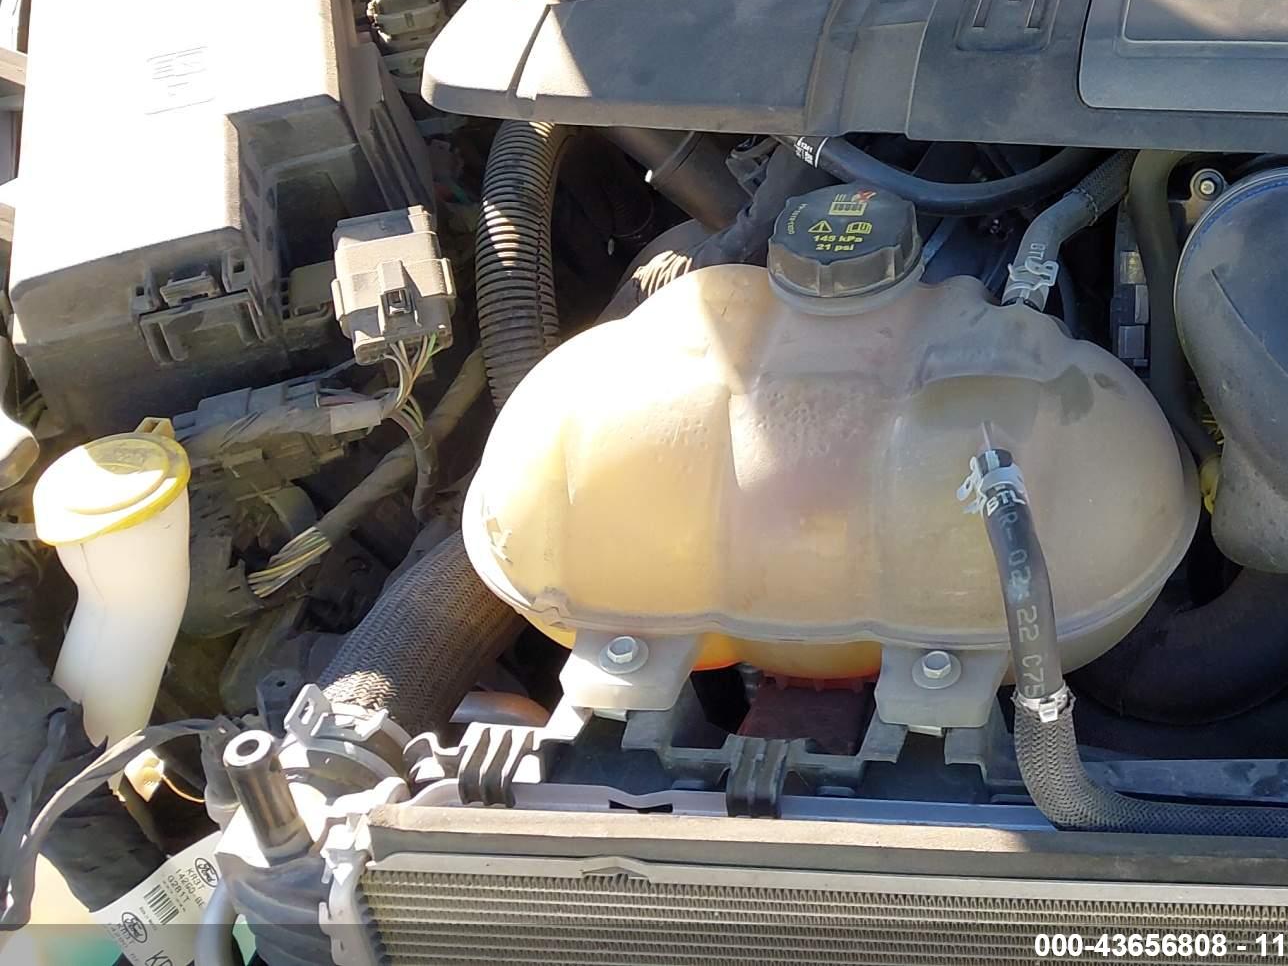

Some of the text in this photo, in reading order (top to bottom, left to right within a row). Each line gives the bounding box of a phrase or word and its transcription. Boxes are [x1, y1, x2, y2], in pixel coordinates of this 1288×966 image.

[813, 234, 863, 243] 145 kPa
[815, 243, 855, 252] 21 psi
